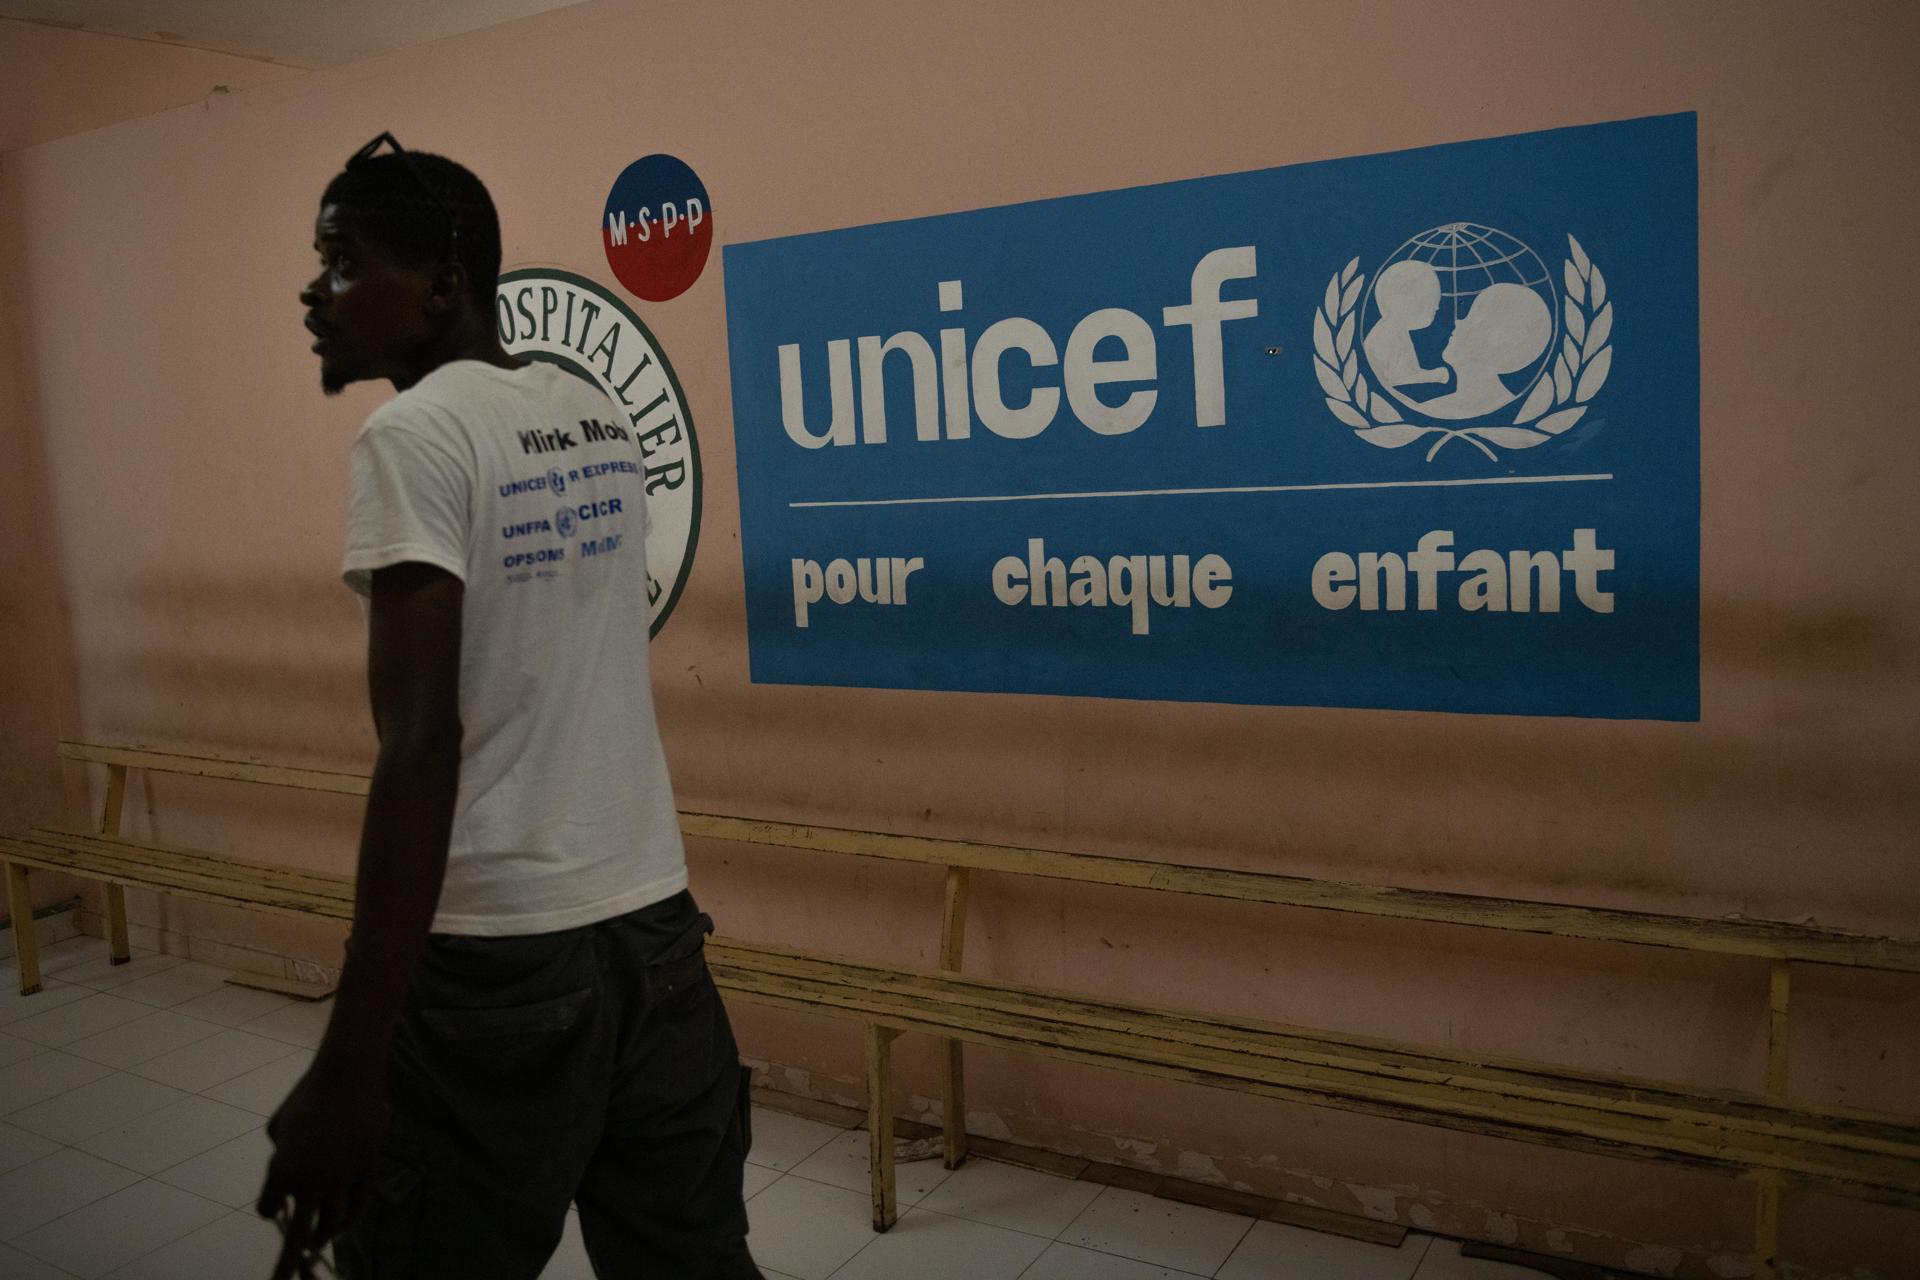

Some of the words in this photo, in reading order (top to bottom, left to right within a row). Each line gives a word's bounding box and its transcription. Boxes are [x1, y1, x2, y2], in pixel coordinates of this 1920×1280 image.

[496, 286, 686, 497] OSPITALIER
[778, 245, 1260, 450] unicef
[502, 519, 552, 540] UNFPA
[578, 498, 623, 521] CICR
[791, 557, 924, 628] pour
[992, 537, 1233, 635] chaque
[1311, 527, 1617, 613] enfant
